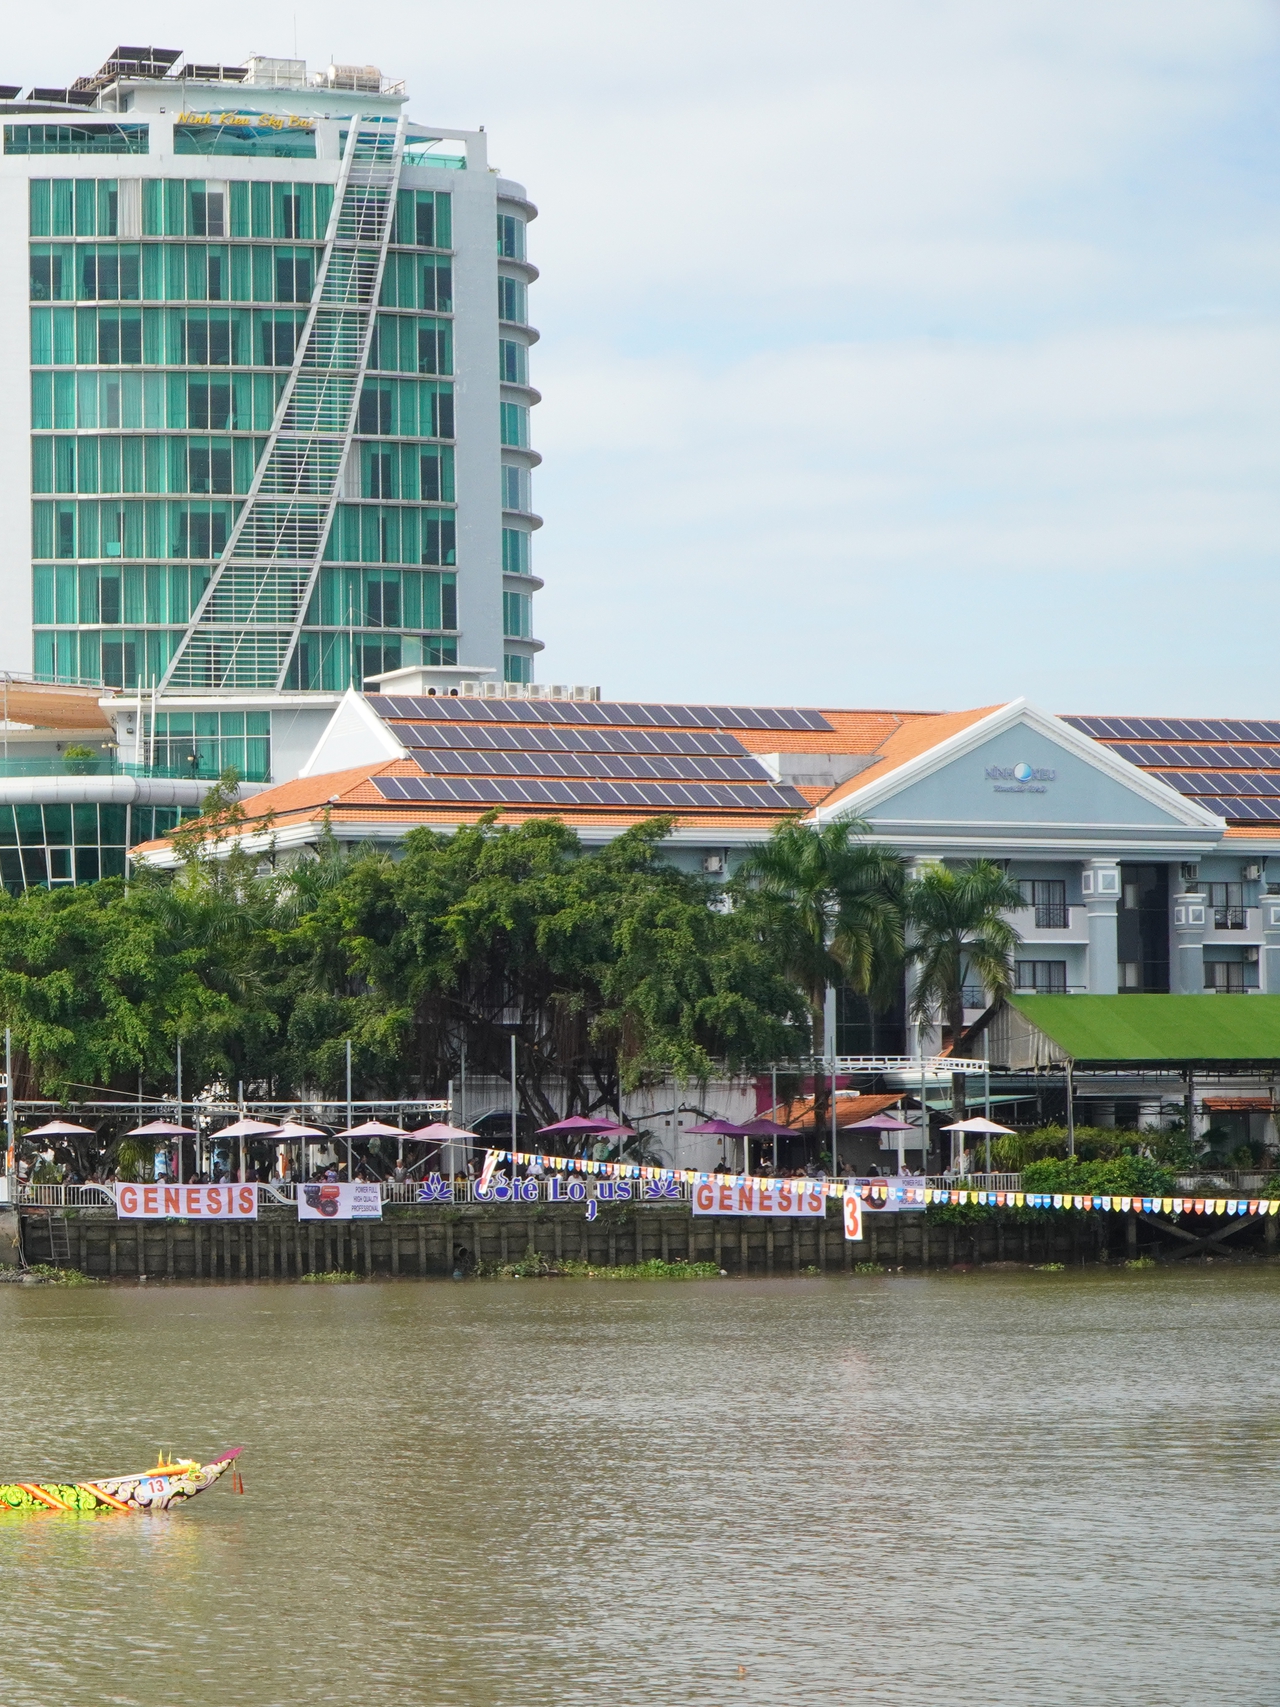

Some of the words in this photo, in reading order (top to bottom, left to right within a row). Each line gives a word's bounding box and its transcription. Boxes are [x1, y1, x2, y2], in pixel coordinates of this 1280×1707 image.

[177, 112, 213, 125] Ninh
[219, 112, 251, 126] Kieu
[258, 114, 285, 130] Sky
[288, 115, 318, 128] Bar
[120, 1186, 254, 1214] GENESIS
[697, 1184, 822, 1212] GENESIS
[845, 1196, 859, 1237] 3
[148, 1479, 165, 1494] 13
